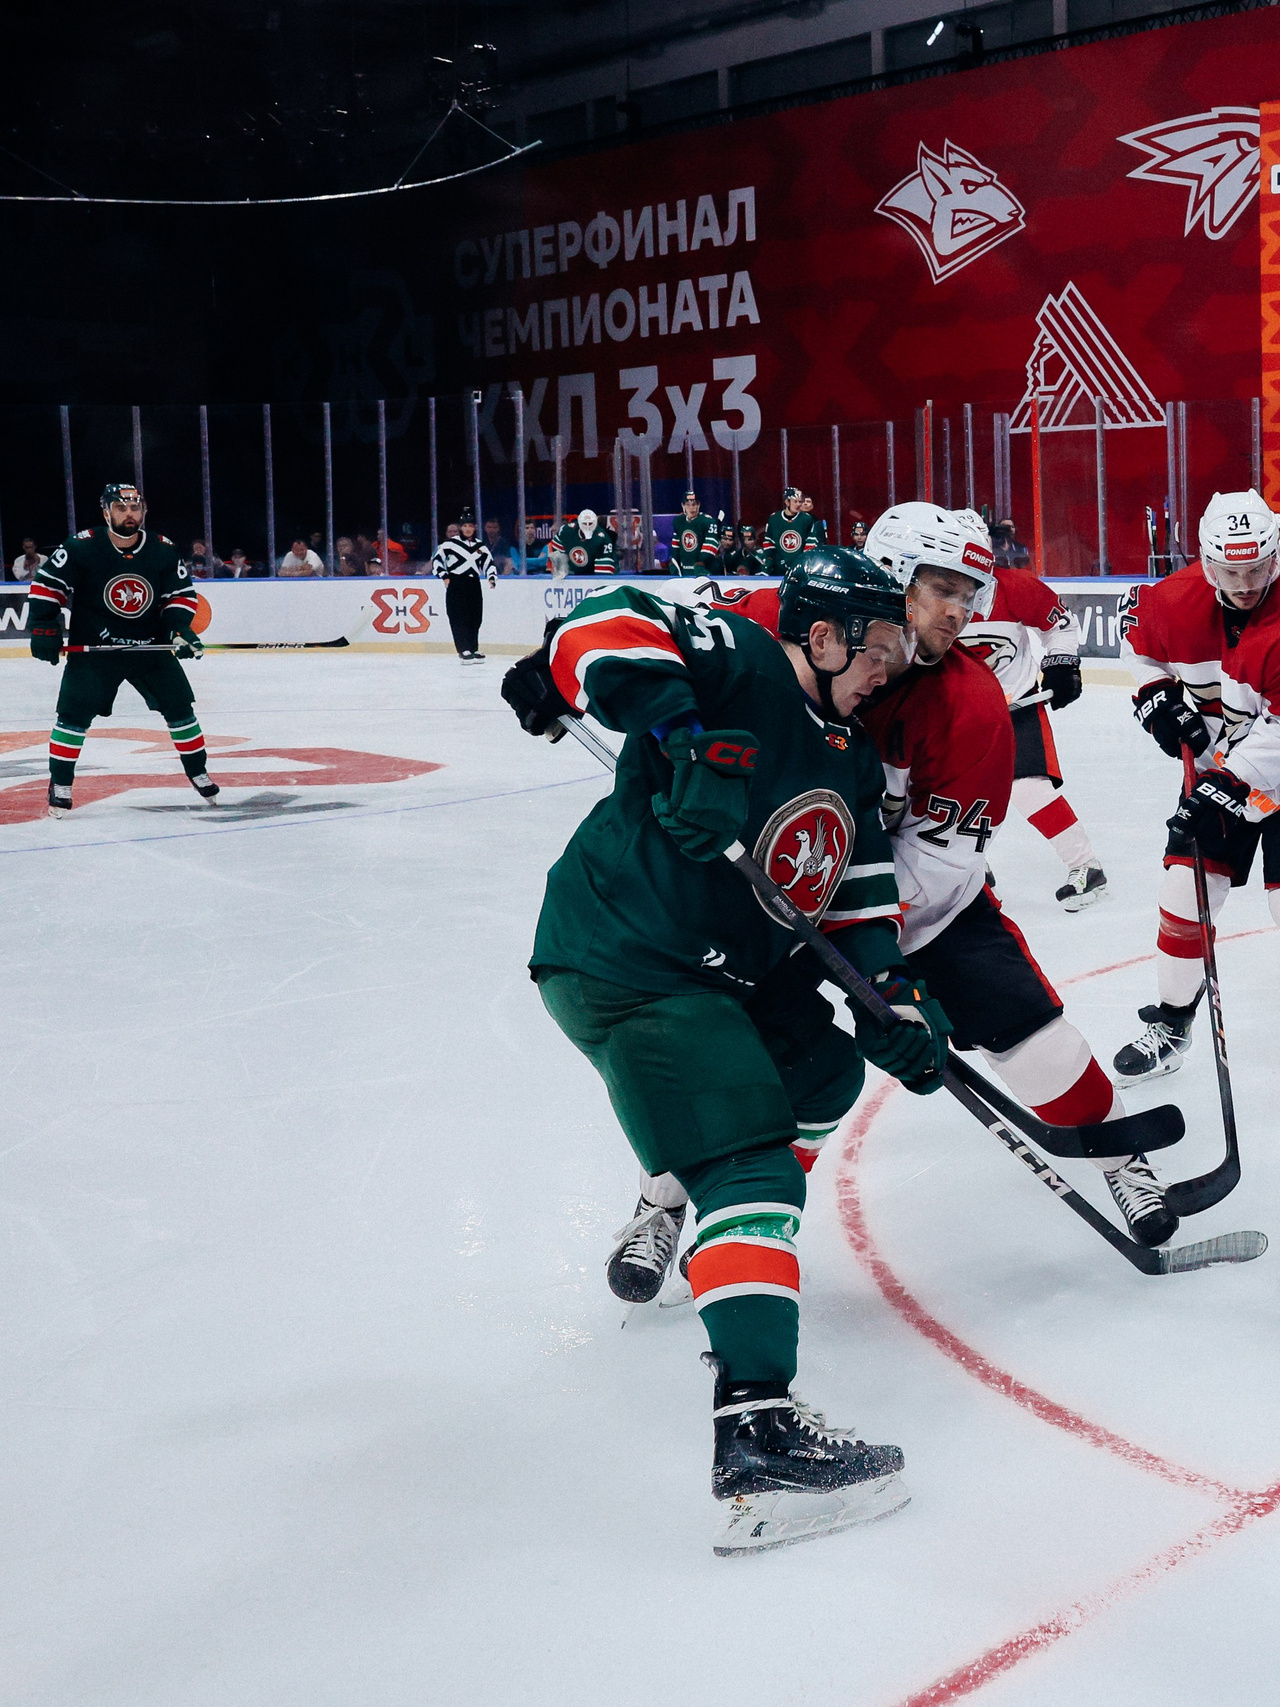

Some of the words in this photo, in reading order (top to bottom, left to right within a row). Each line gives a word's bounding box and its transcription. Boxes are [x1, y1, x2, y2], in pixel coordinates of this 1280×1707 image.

[454, 186, 756, 288] СУПЕРФИНАЛ
[458, 270, 761, 357] ЧЕМПИОНАТА
[462, 373, 598, 465] КХЛ
[1225, 546, 1258, 556] FONBET
[1227, 514, 1250, 531] 34
[964, 549, 993, 568] FONBET
[917, 794, 992, 853] 24
[989, 1121, 1072, 1196] CCM
